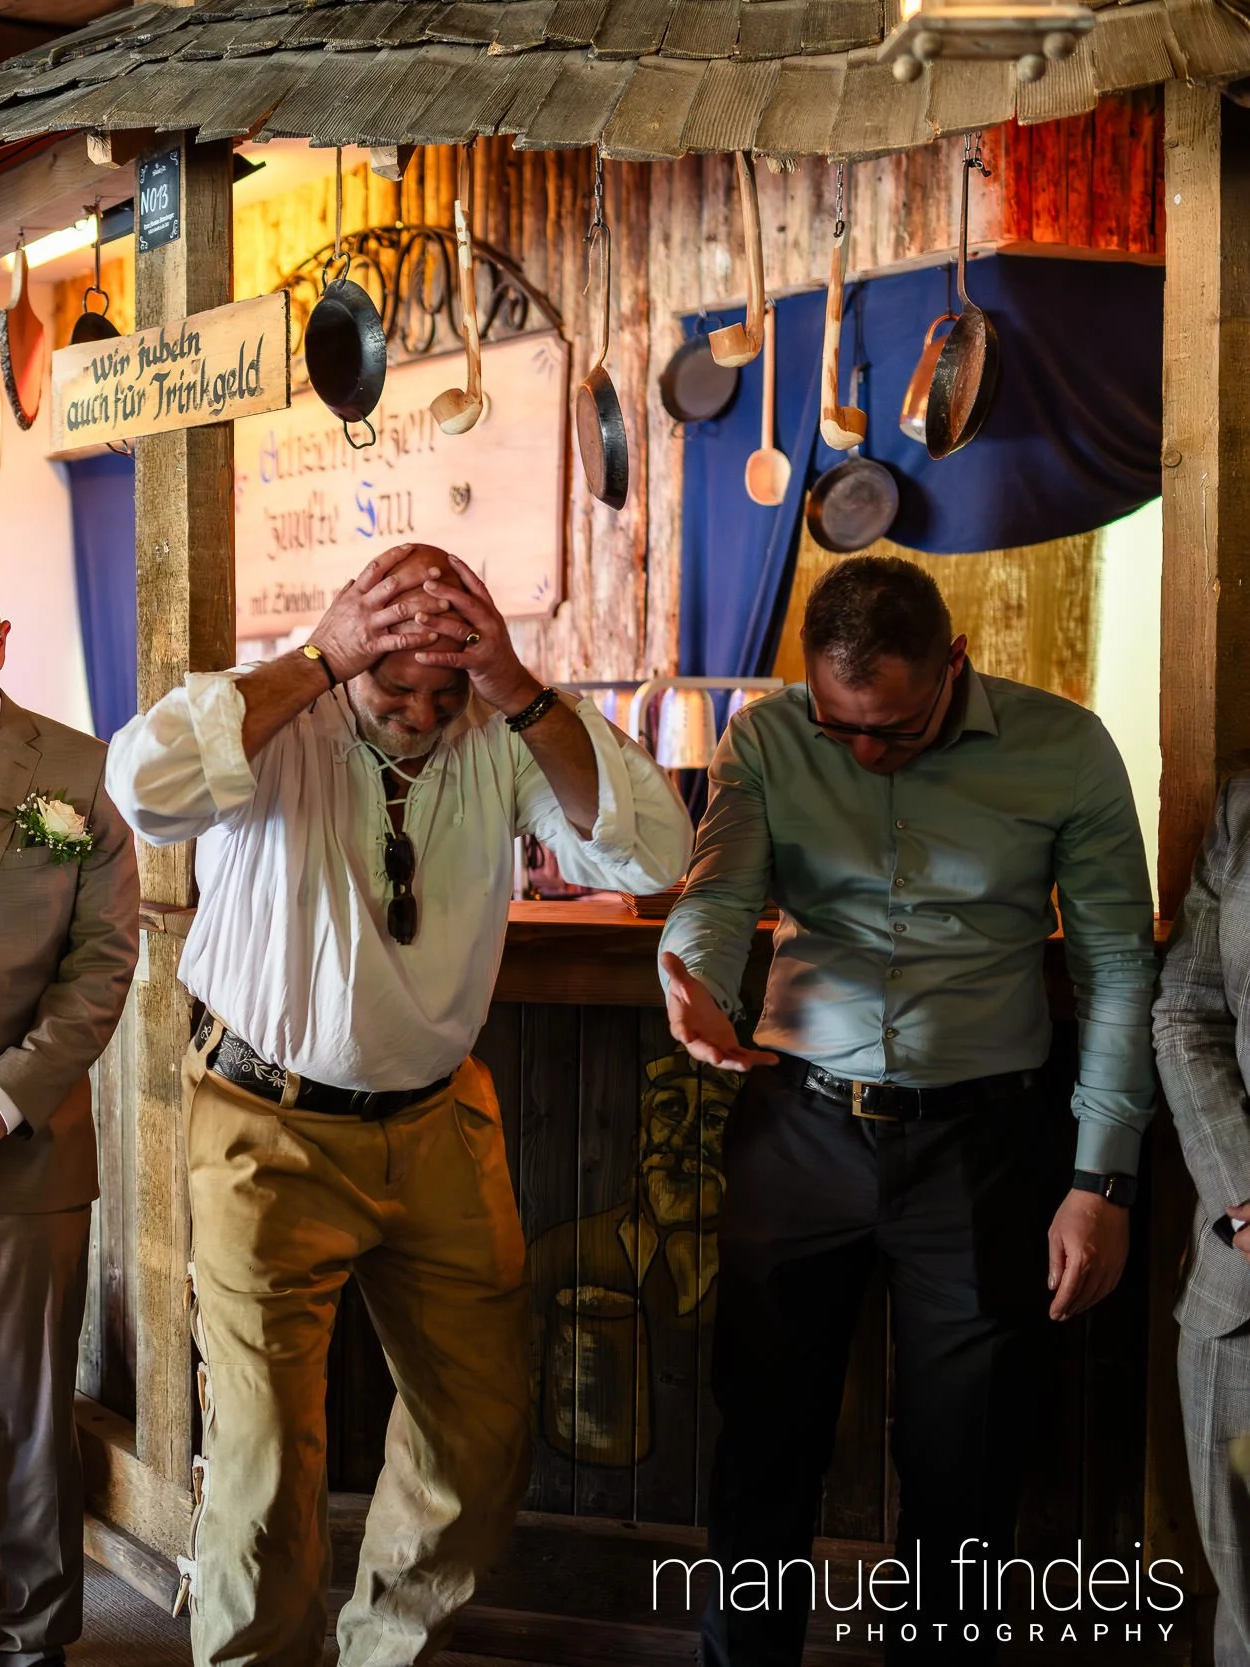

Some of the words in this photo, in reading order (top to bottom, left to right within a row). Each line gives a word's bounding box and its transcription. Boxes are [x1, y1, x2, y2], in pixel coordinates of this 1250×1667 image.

[67, 388, 110, 431] auch
[112, 379, 146, 430] für
[150, 332, 265, 420] Trinkgeld
[135, 321, 201, 381] jubeln
